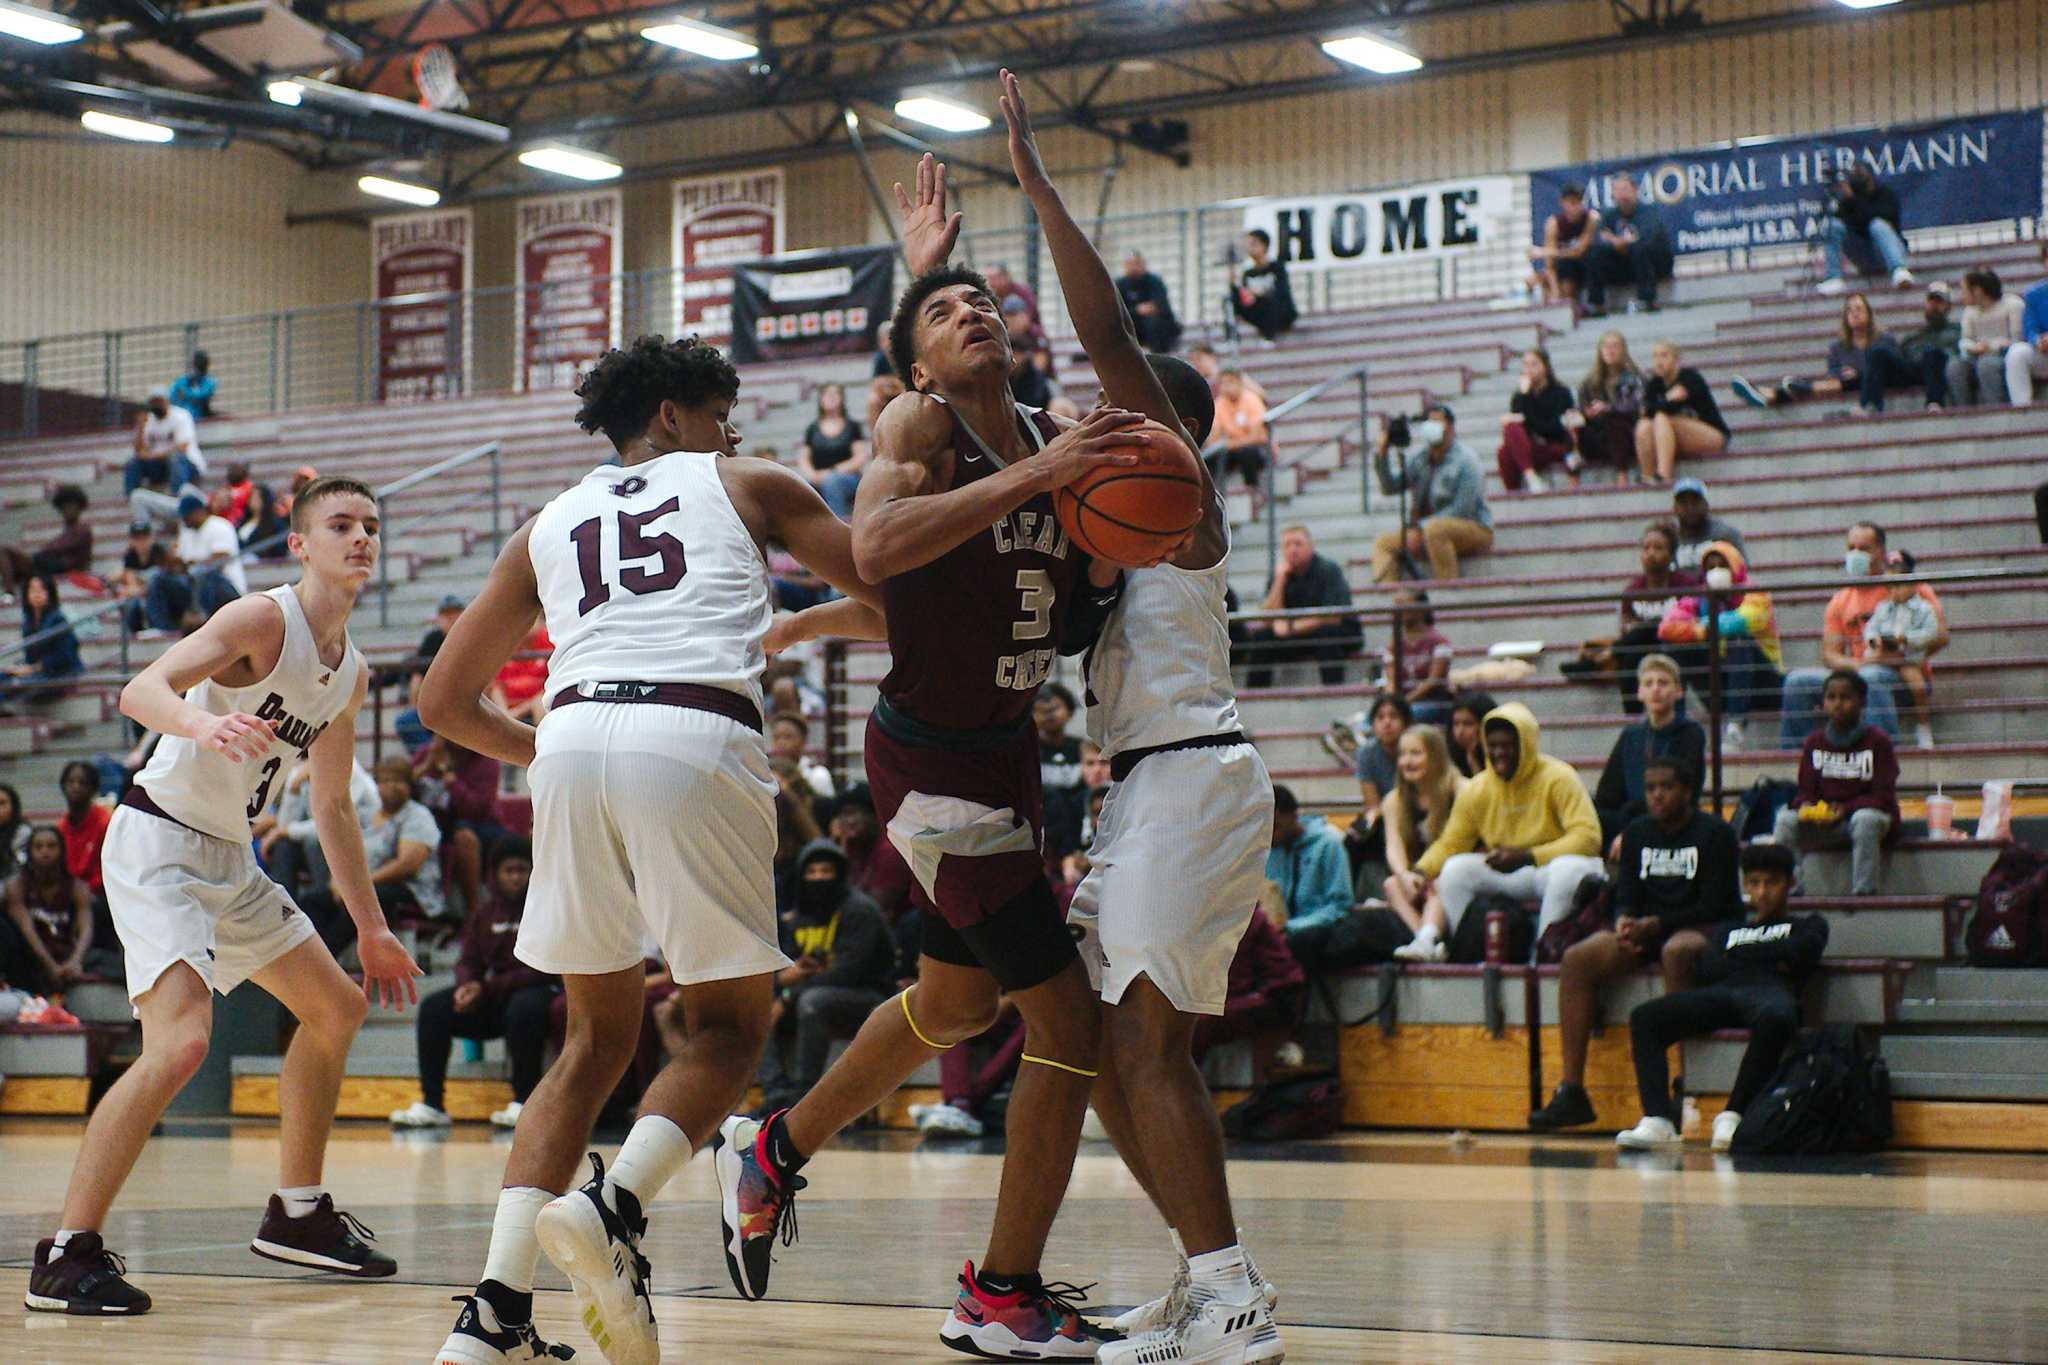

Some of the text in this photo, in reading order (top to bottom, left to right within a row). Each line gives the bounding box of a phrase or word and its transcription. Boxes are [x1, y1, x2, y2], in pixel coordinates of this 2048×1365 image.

[1275, 189, 1478, 262] HOME
[570, 495, 687, 618] 15
[1012, 569, 1056, 640] 3
[246, 756, 281, 819] 3
